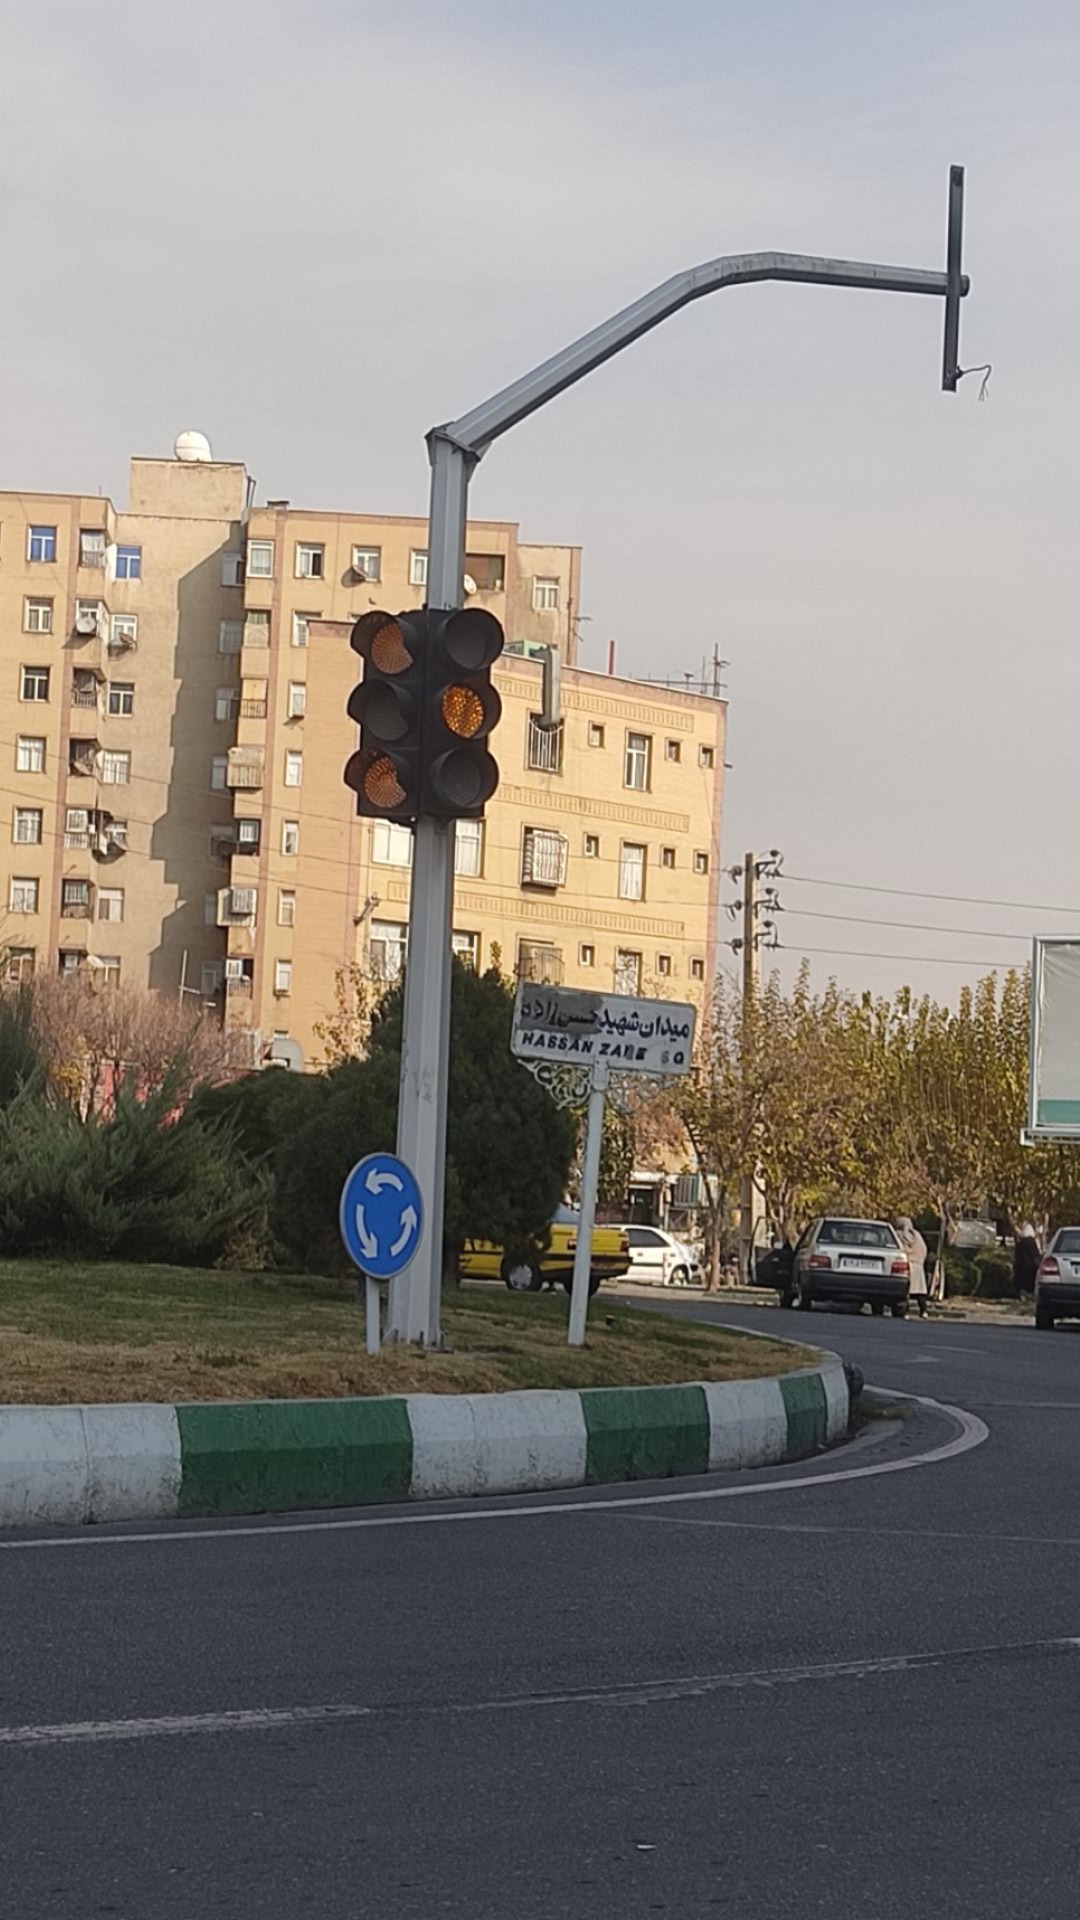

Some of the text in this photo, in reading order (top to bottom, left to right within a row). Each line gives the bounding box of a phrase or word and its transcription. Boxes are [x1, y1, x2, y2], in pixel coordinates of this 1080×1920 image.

[598, 1008, 640, 1037] شهید
[638, 1014, 691, 1043] میدان
[522, 1031, 594, 1054] HASSAN
